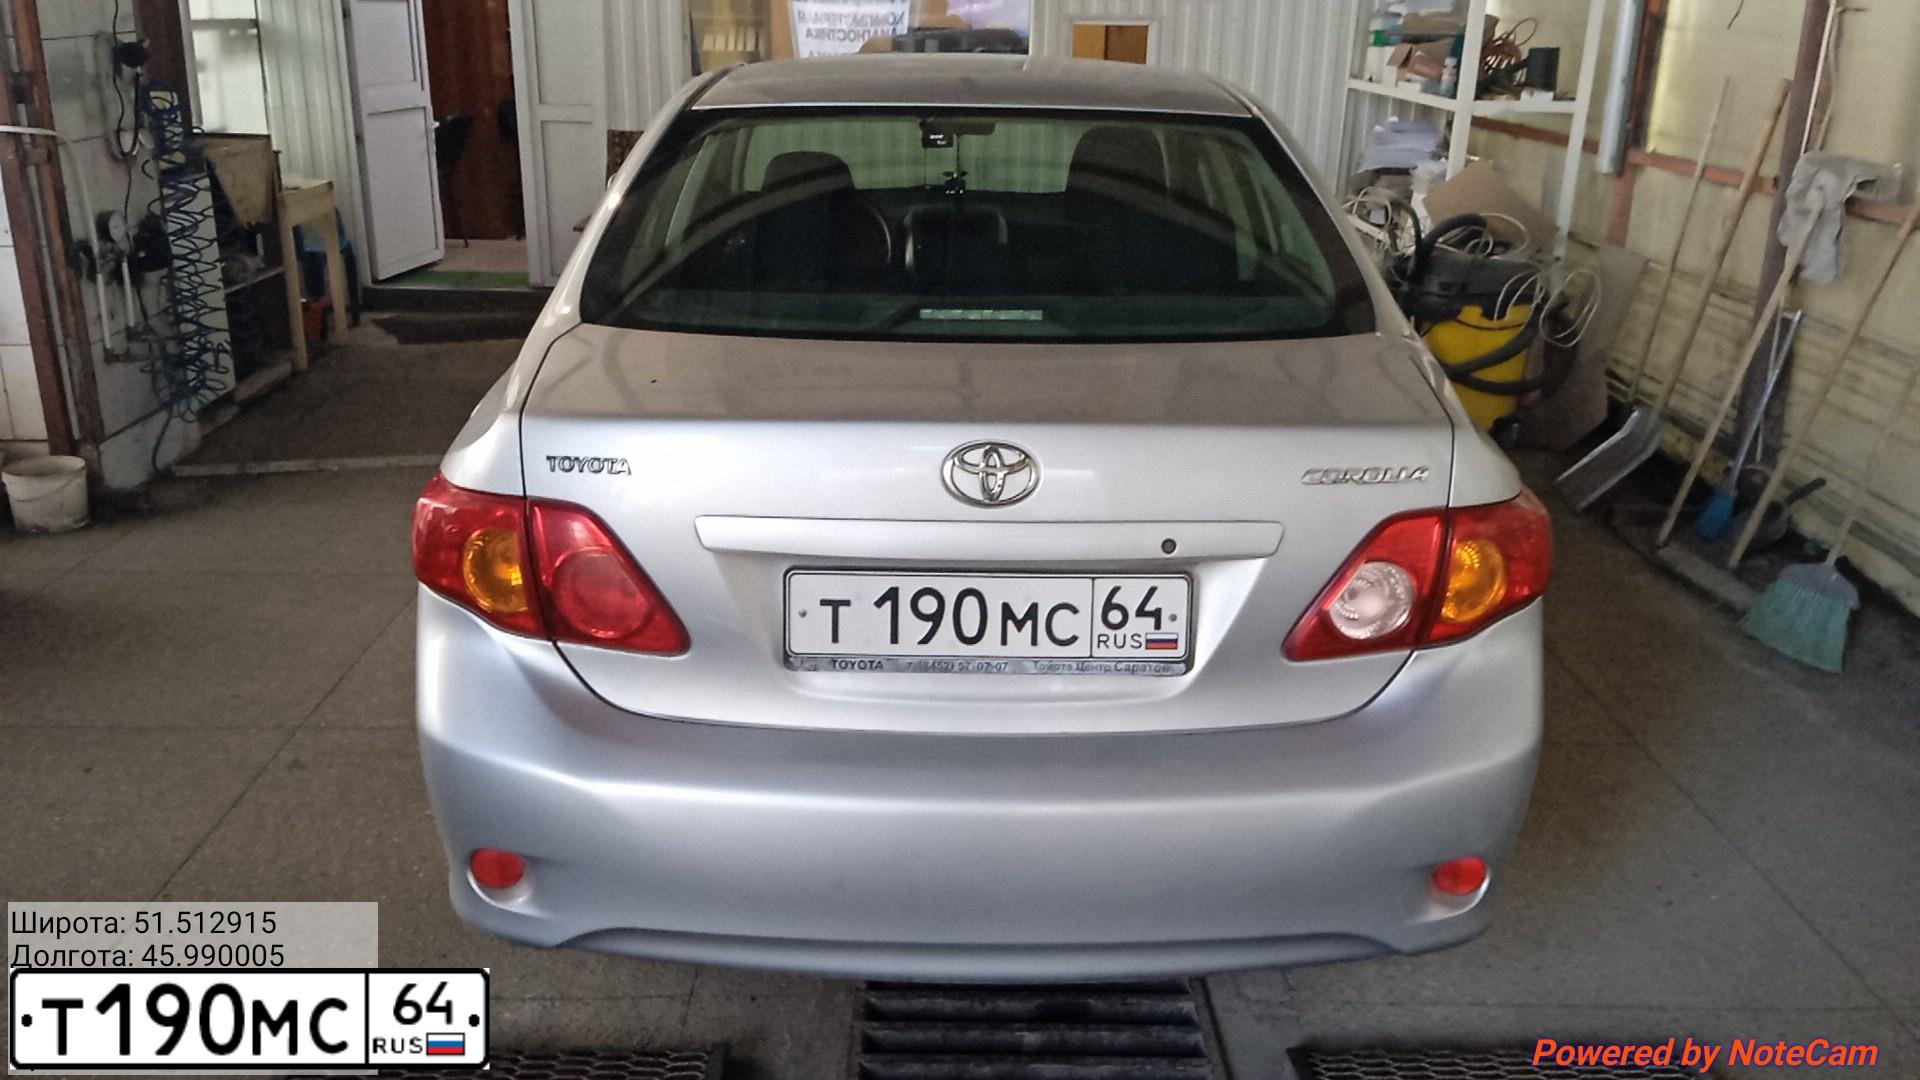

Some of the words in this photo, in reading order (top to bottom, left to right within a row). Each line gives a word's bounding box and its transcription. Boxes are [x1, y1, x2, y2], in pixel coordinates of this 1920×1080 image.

[546, 455, 632, 475] TOYOTA
[1301, 465, 1430, 485] COROLLA
[1101, 585, 1162, 631] 64
[1097, 634, 1143, 650] RUS
[831, 659, 884, 671] TOYOTA
